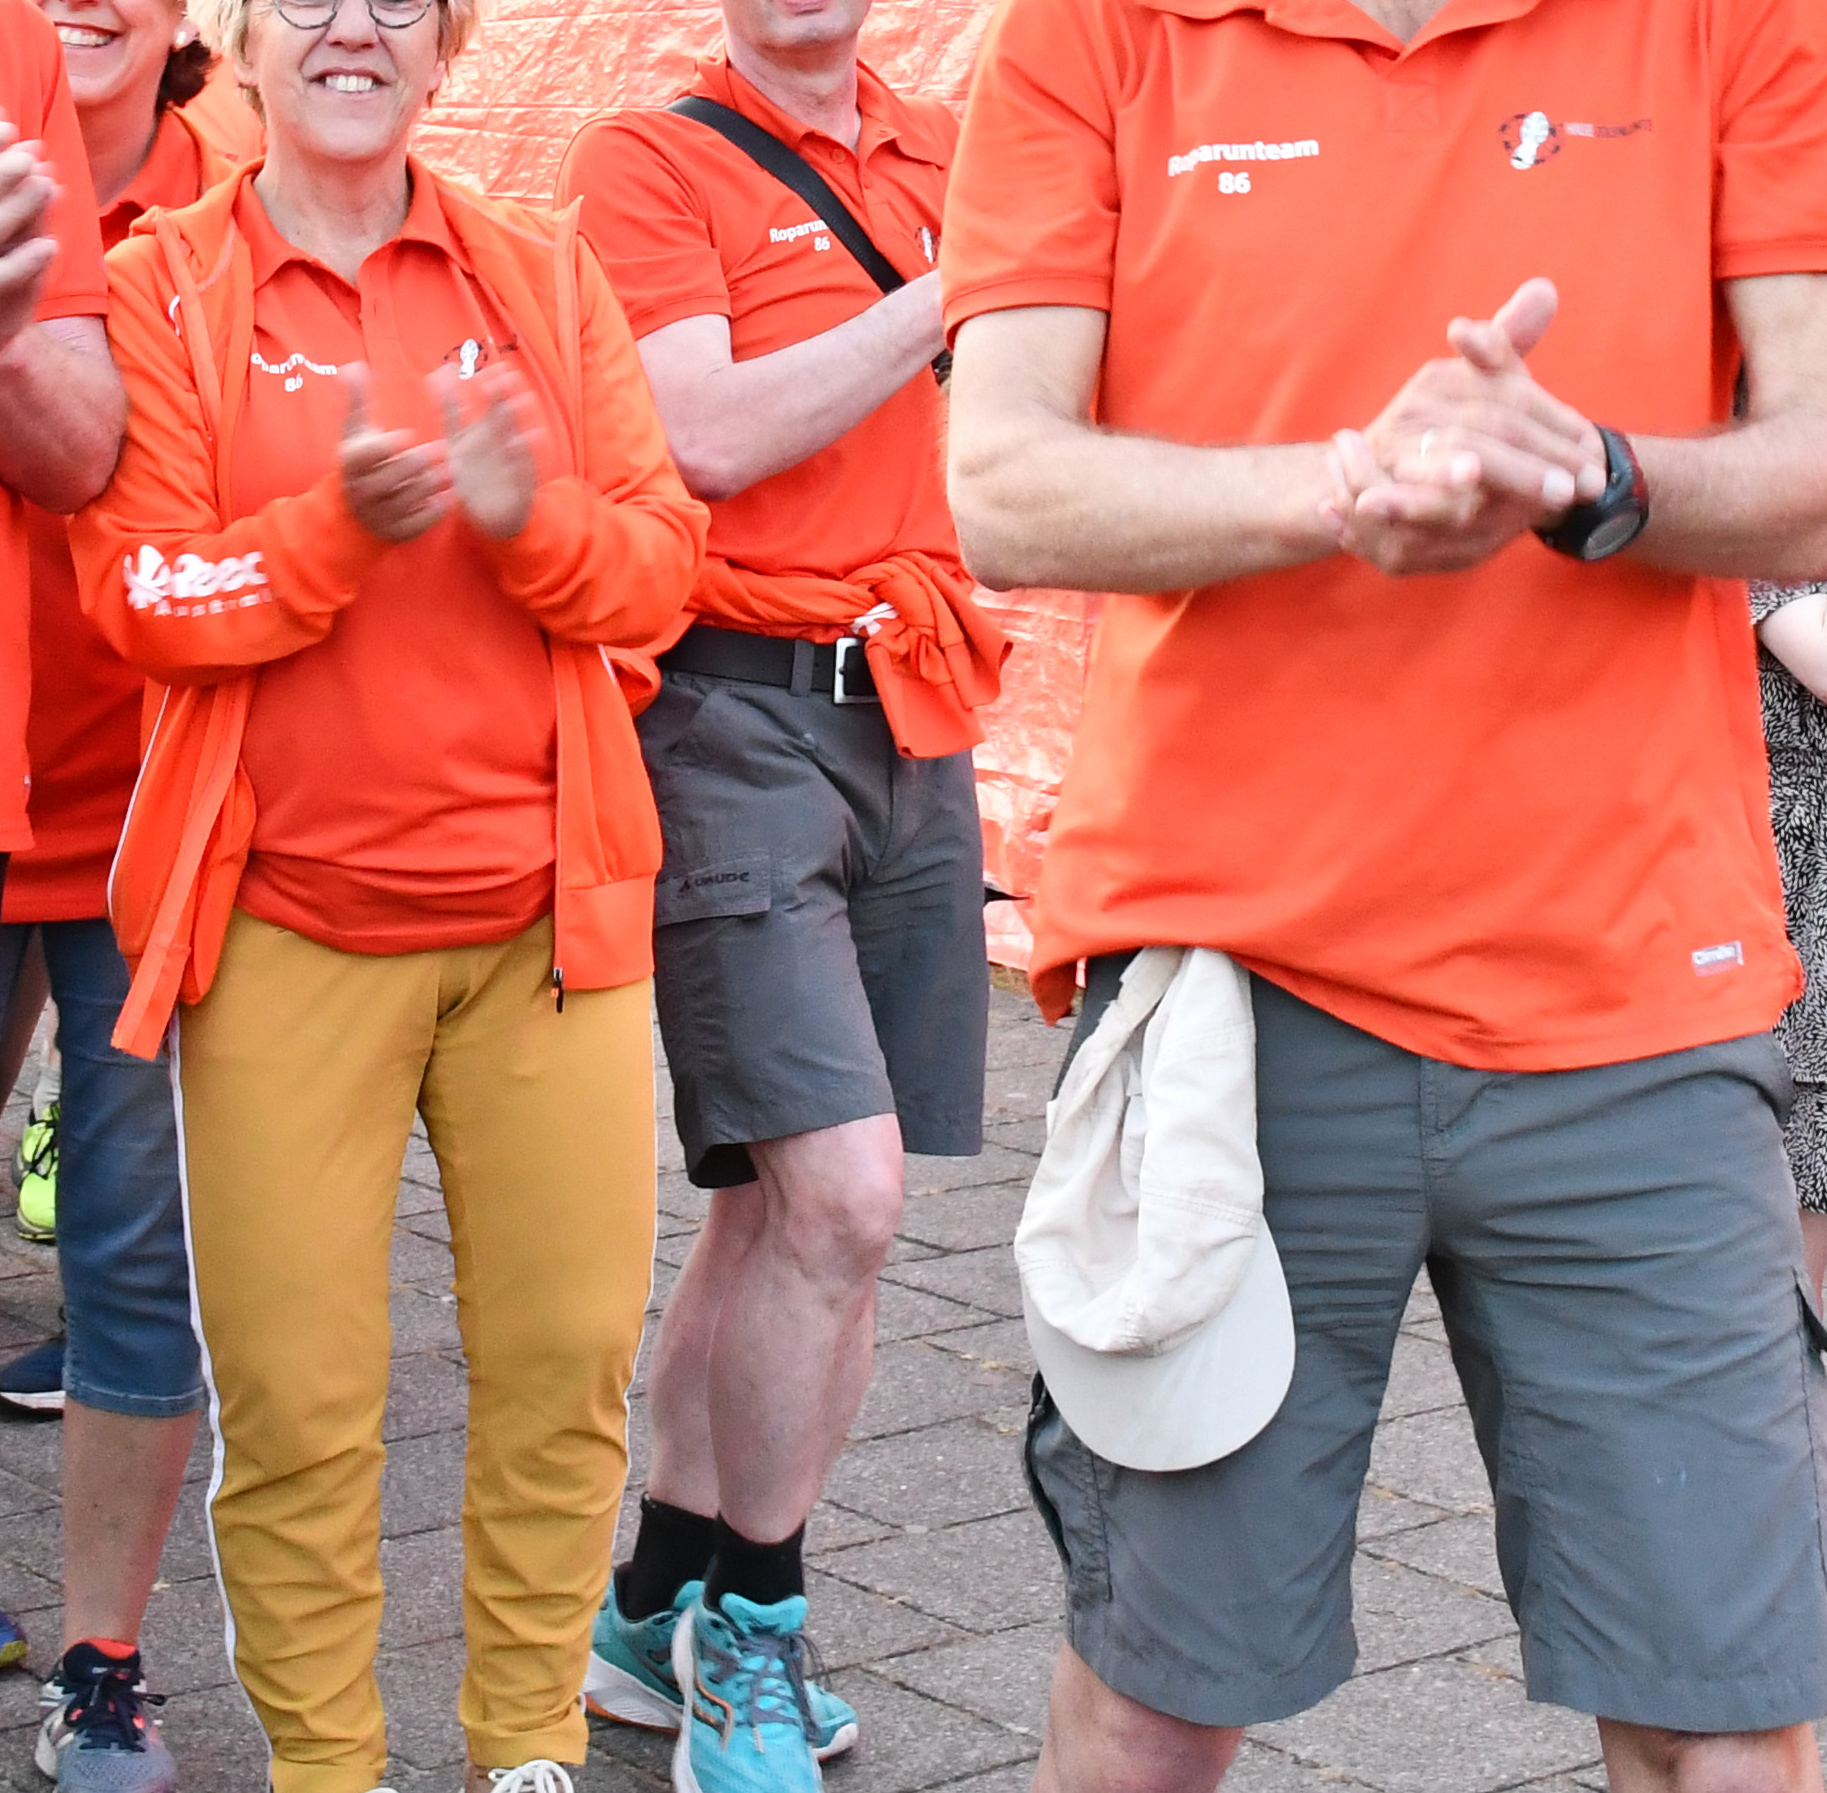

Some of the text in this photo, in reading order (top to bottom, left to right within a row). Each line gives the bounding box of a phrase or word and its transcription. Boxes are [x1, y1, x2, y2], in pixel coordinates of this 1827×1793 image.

[1218, 171, 1251, 194] 86
[769, 218, 830, 244] Roparun
[814, 235, 831, 252] 86
